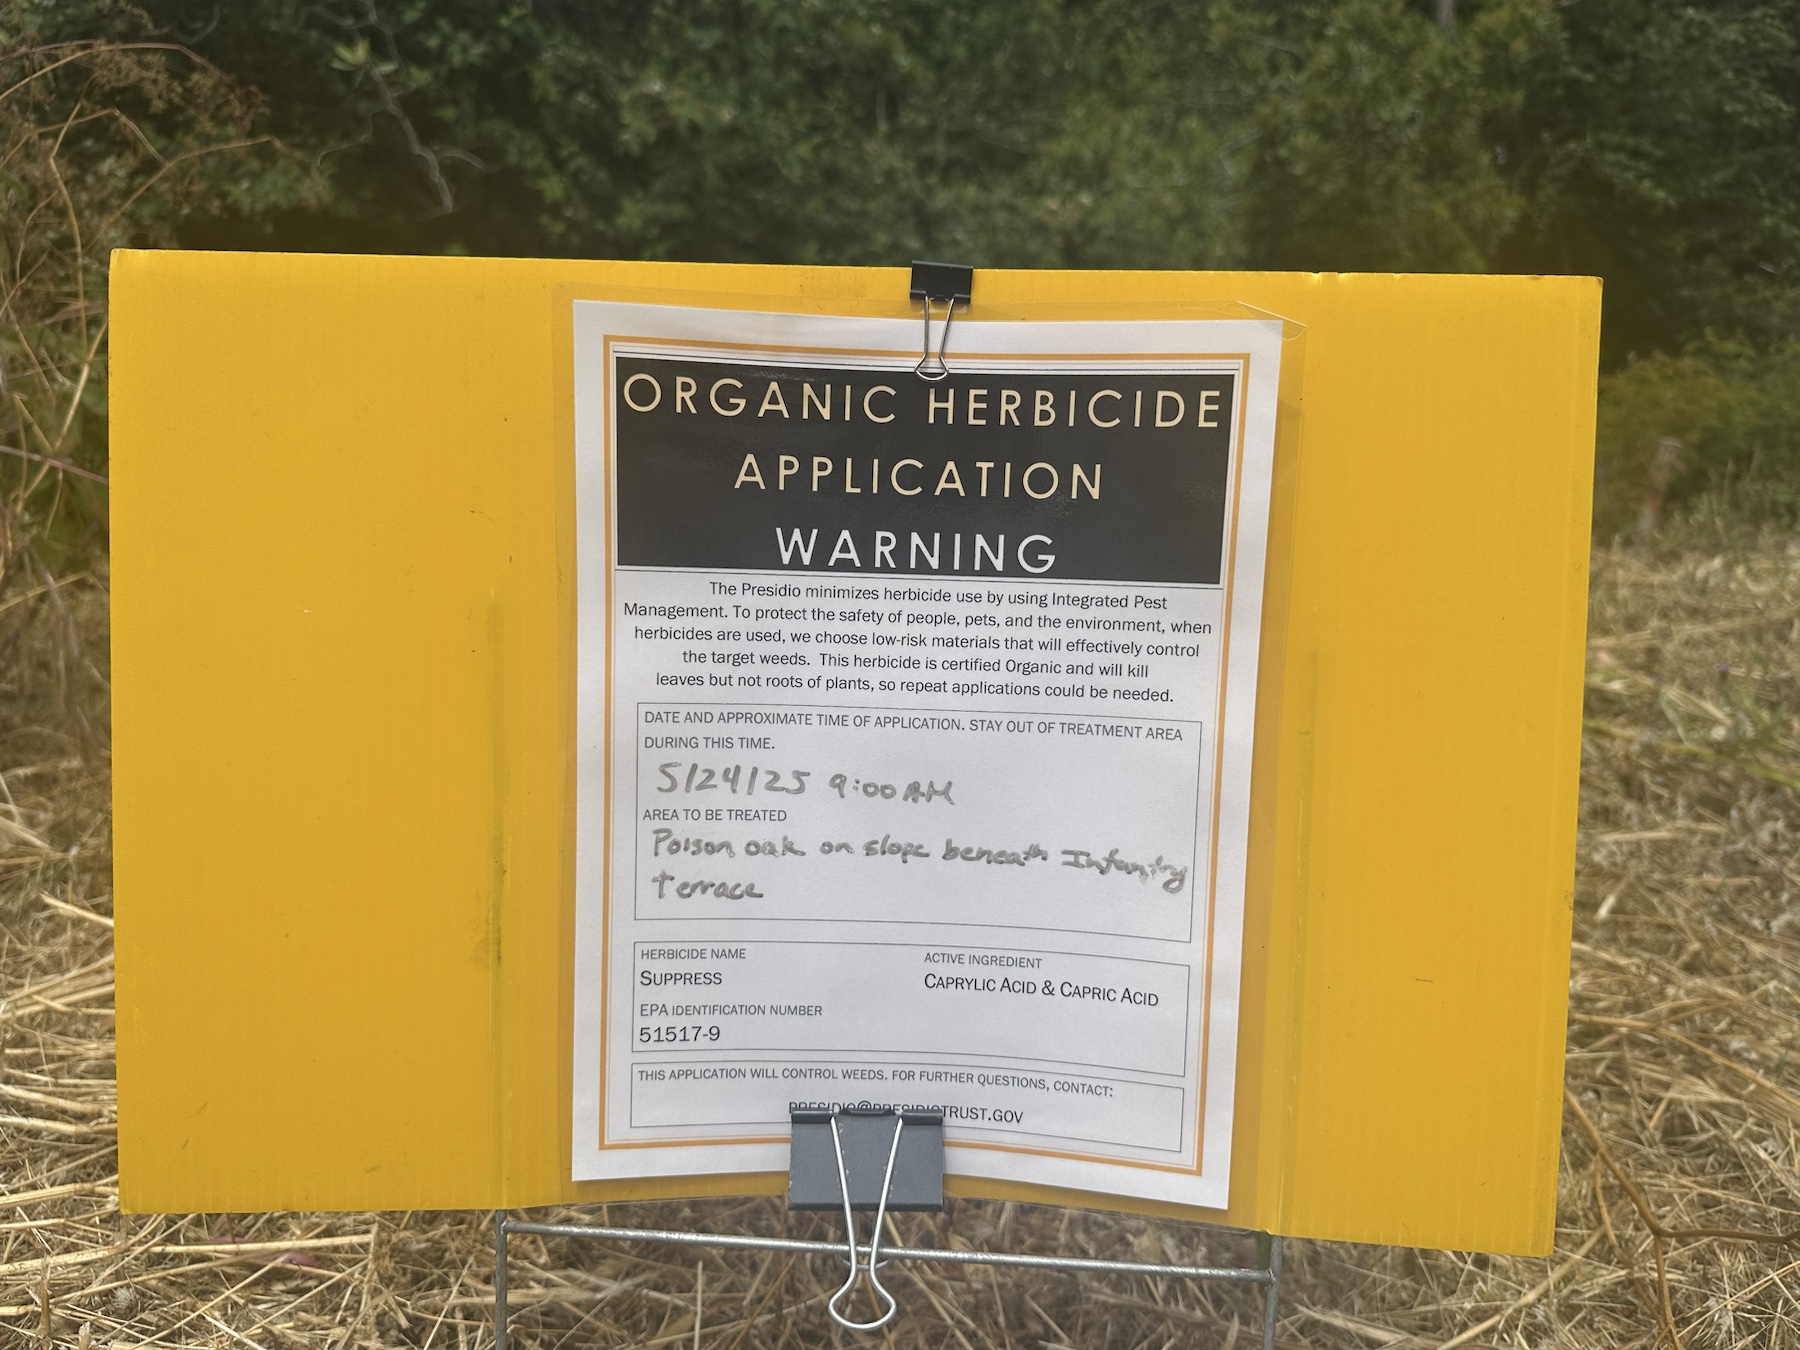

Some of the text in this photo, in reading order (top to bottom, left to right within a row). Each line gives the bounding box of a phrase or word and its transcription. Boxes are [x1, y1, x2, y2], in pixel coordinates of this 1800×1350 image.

[623, 373, 1220, 428] ORGANIC HERBICIDE
[734, 453, 1101, 500] APPLICATION
[775, 527, 1055, 573] WARNING
[709, 581, 1167, 610] The Presidio minimizes herbicide use by using Integrated Pest
[624, 602, 1211, 634] Management. To protect the safety of people, pets, and the environment, when
[634, 625, 1199, 658] herbicides are used, we choose low-risk materials that will effectively control
[682, 649, 1148, 678] the target weeds. This herbicide is certified Organic and will kill
[656, 672, 1173, 702] leaves but not roots of plants, so repeat applications could be needed.
[644, 710, 1183, 741] DATE AND APPROXIMATE TIME OF APPLICATION. STAY OUT OF TREATMENT AREA
[644, 736, 775, 749] DURING THIS TIME.
[656, 761, 811, 796] 5/24/25
[642, 808, 787, 822] AREA TO BE TREATED
[652, 827, 1188, 894] Poison oak on slope beneath Infantry
[641, 948, 746, 960] HERBICIDE NAME
[923, 952, 1042, 969] ACTIVE INGREDIENT
[1041, 979, 1055, 996] &
[640, 1003, 822, 1017] EPA IDENTIFICATION NUMBER
[639, 1025, 720, 1043] 51517-9
[637, 1067, 1113, 1098] THIS APPLICATION WILL CONTROL WEEDS. FOR FURTHER QUESTIONS, CONTACT:
